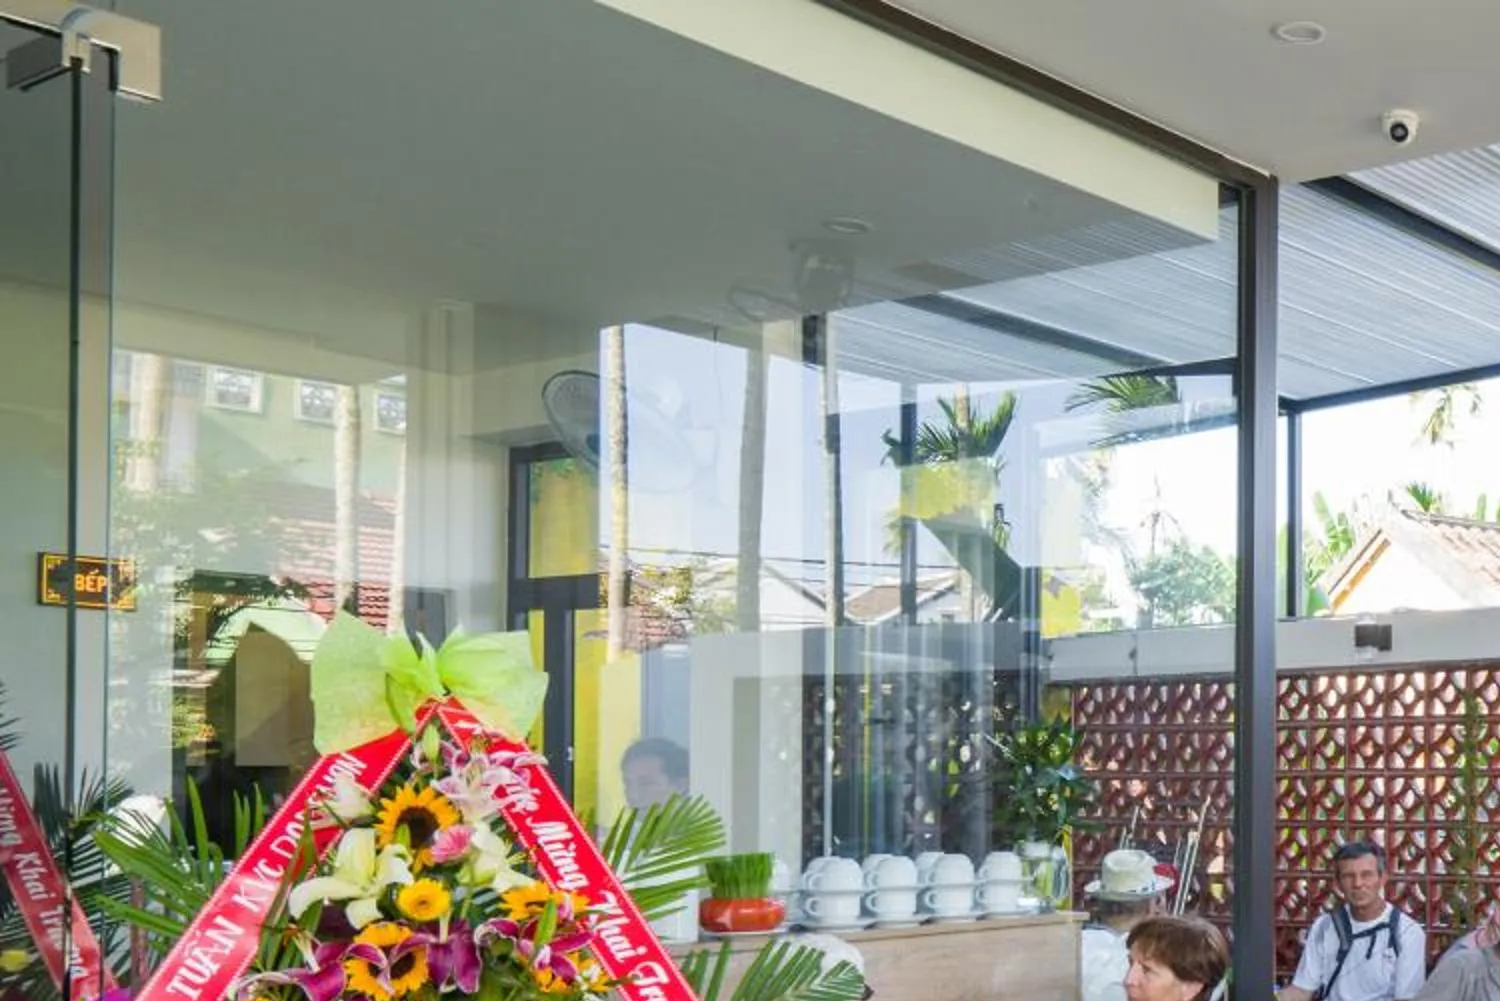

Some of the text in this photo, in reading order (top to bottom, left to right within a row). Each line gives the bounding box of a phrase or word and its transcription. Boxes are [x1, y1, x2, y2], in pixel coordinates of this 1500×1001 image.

[75, 569, 107, 592] BẾP
[14, 851, 54, 900] Khai
[525, 816, 589, 890] Mừng
[591, 891, 646, 963] Khai
